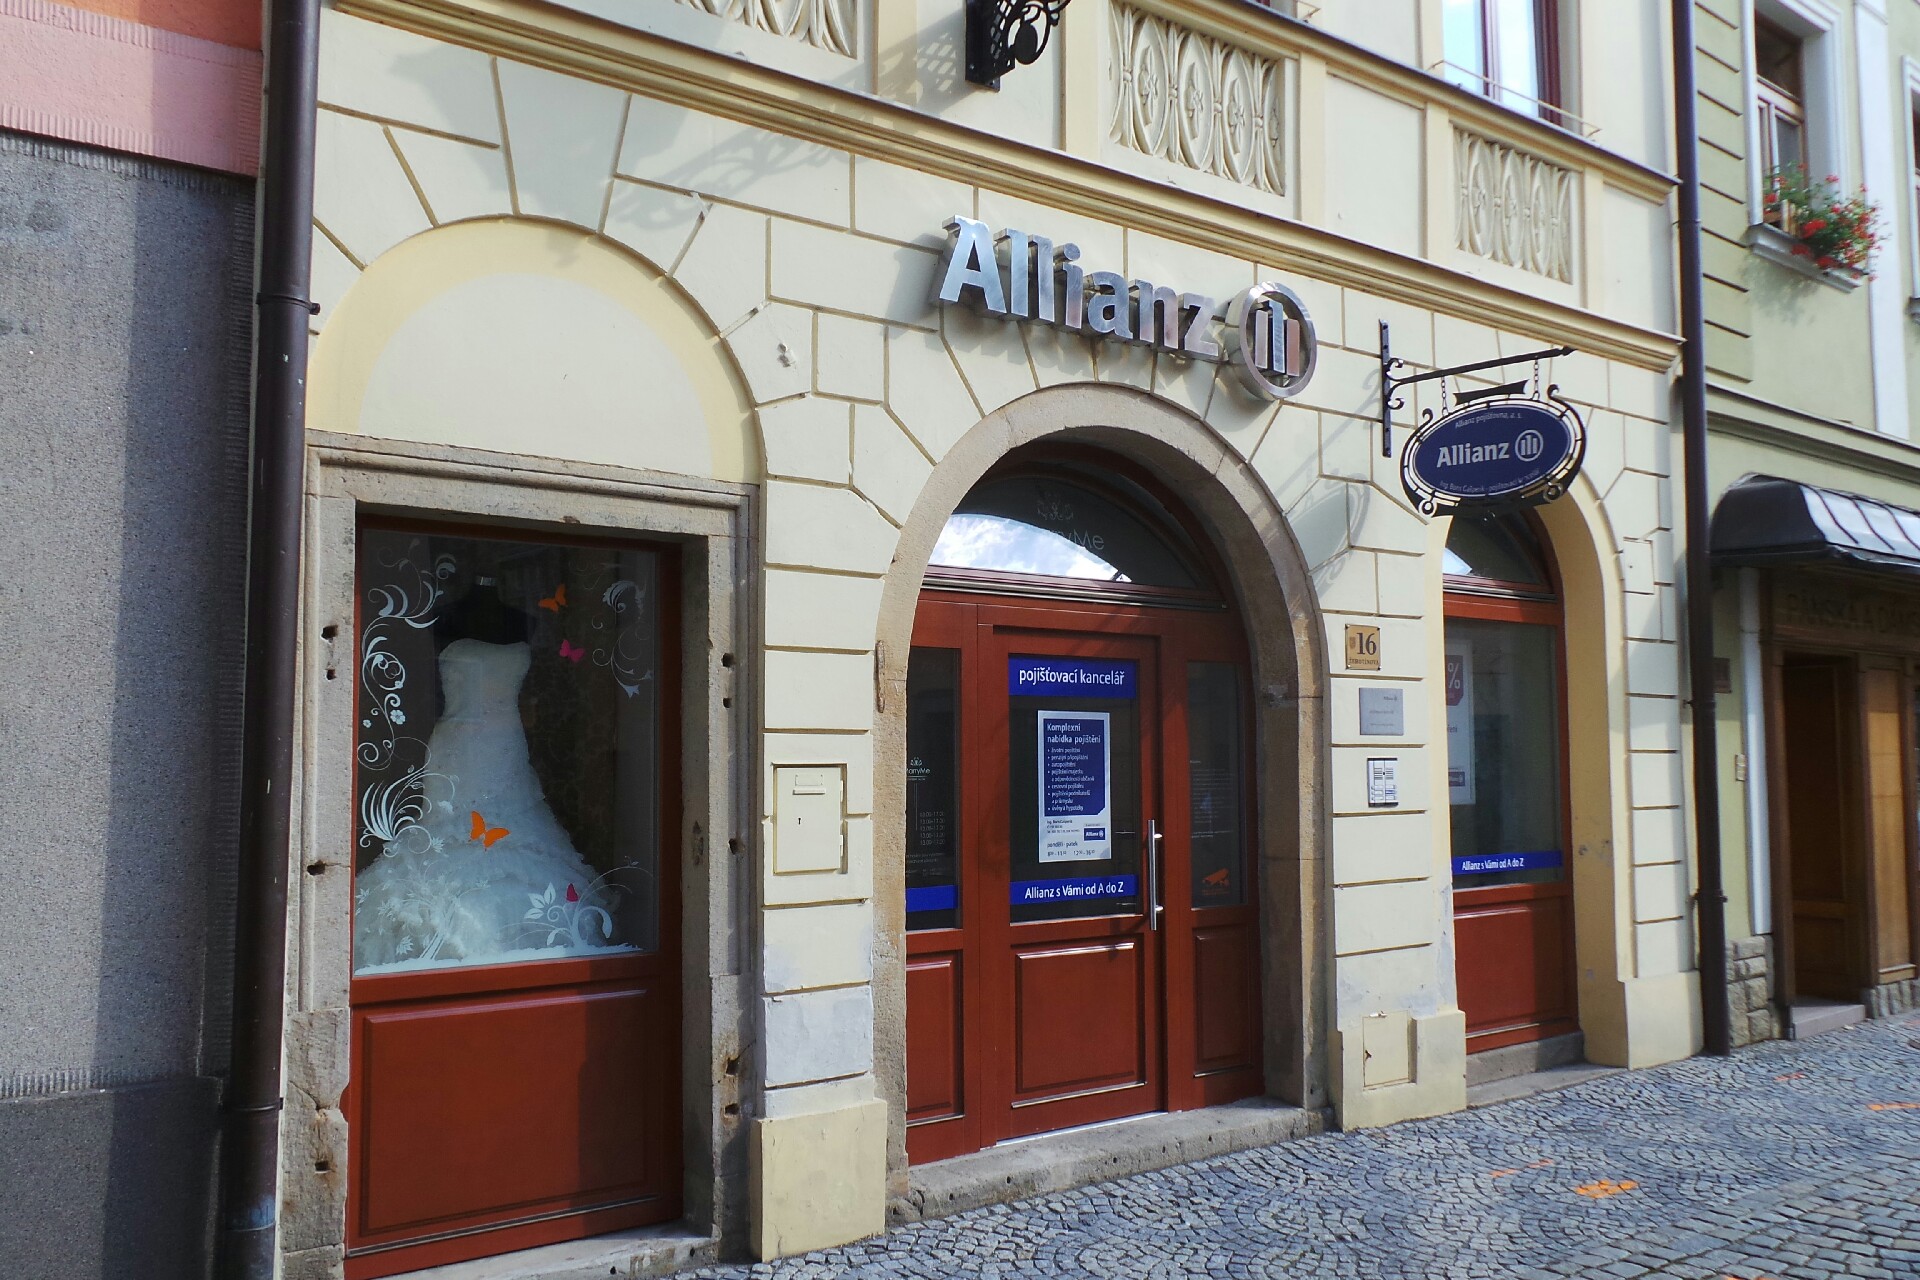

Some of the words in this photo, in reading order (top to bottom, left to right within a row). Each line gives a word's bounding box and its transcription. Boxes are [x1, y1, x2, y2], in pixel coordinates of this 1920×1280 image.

[939, 215, 1219, 358] Allianz
[1436, 442, 1510, 468] Allianz
[1356, 632, 1377, 655] 16
[1019, 667, 1078, 685] pojišťovací
[1080, 668, 1125, 685] kancelář
[1047, 735, 1073, 743] nabídka
[1461, 860, 1480, 871] Allianz
[1485, 859, 1499, 869] Vámi
[1499, 859, 1506, 868] od
[1507, 859, 1512, 867] A
[1512, 858, 1519, 867] do
[1519, 857, 1525, 867] Z
[1024, 887, 1055, 899] Allianz
[1056, 889, 1060, 897] s
[1062, 884, 1084, 896] Vámi
[1085, 883, 1096, 895] od
[1098, 883, 1105, 894] A
[1105, 882, 1116, 893] do
[1117, 881, 1124, 892] Z
